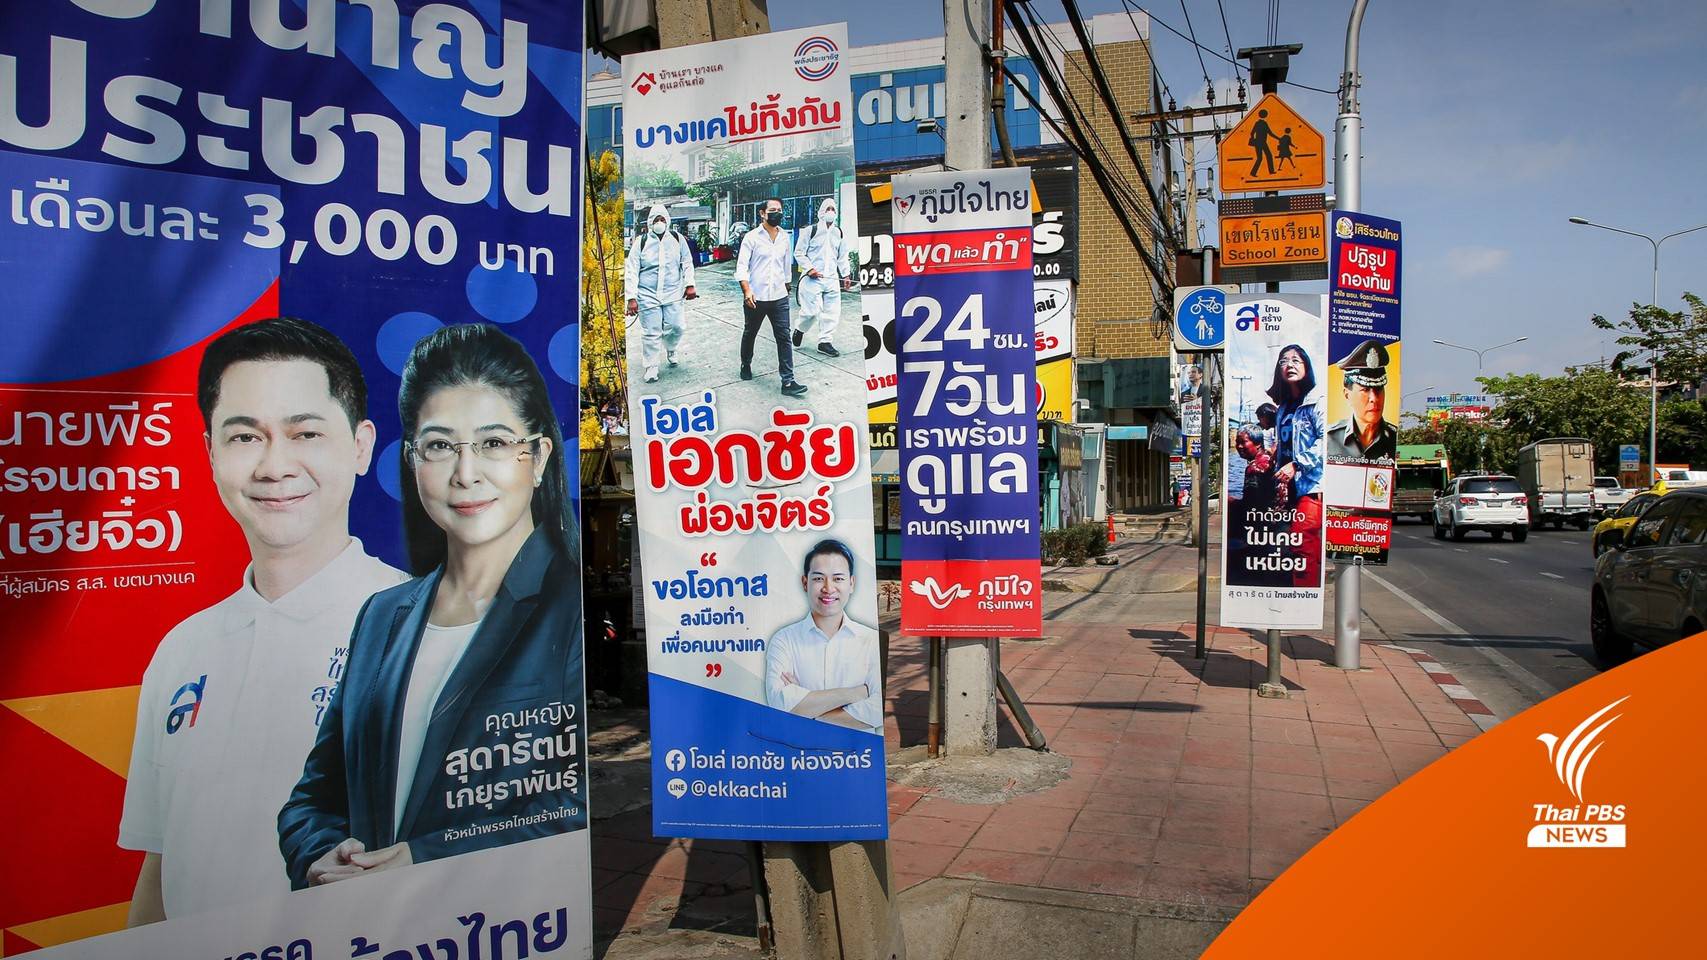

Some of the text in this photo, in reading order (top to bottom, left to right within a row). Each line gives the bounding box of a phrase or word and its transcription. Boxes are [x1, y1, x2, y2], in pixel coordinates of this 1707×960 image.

[659, 64, 724, 80] บ้านเรา บางแค
[659, 77, 705, 93] ดูแลกันต่อ
[0, 35, 572, 216] ประชาชน
[635, 93, 841, 149] บางแคไม่ทิ้งกัน
[919, 181, 1029, 223] ภูมิใจไทย
[11, 177, 555, 276] เดือนละ 3,000 บาท
[1225, 221, 1321, 244] เขตโรงเรียน
[954, 245, 979, 259] แล้ว
[1228, 246, 1320, 261] School Zone
[1348, 246, 1387, 271] ปฏิรูป
[1341, 272, 1391, 291] กองทัพ
[1261, 313, 1282, 322] สร้าง
[1264, 304, 1280, 313] ไทย
[901, 294, 991, 353] 24
[1264, 323, 1280, 332] ไทย
[993, 332, 1028, 349] ชม.
[642, 391, 715, 436] โอเล่
[905, 418, 1027, 449] เราพร้อม
[647, 410, 856, 490] เอกชัย
[0, 457, 181, 493] รจนดารา
[906, 452, 1028, 515] ดูแล
[680, 485, 832, 534] ผ่องจิตร์
[1246, 508, 1306, 523] ทำด้วยใจ
[907, 518, 1030, 541] คนกรุงเทพฯ
[1244, 526, 1304, 546] ไม่เคย
[1245, 548, 1307, 572] เหนื่อย
[77, 577, 108, 590] ส.ส.
[114, 572, 195, 588] เขตบางแค
[653, 569, 768, 600] ขอโอกาส
[978, 574, 1033, 600] ภูมิใจ
[1274, 589, 1319, 599] ไทยสร้างไทย
[680, 606, 744, 627] ลงมือทำ
[977, 601, 1033, 613] กรุงเทพฯ
[661, 630, 765, 654] เพื่อคนบางแค
[485, 702, 576, 737] คุณหญิง
[445, 724, 577, 784] สุดารัตน์
[690, 747, 873, 771] โอเล่ เอกชัย ผ่องจิตร์
[446, 762, 578, 810] เกยุราพันธุ์
[669, 780, 788, 798] LINE @ekkachai
[444, 806, 579, 841] หัวหน้าพรรคไทยสร้างไทย
